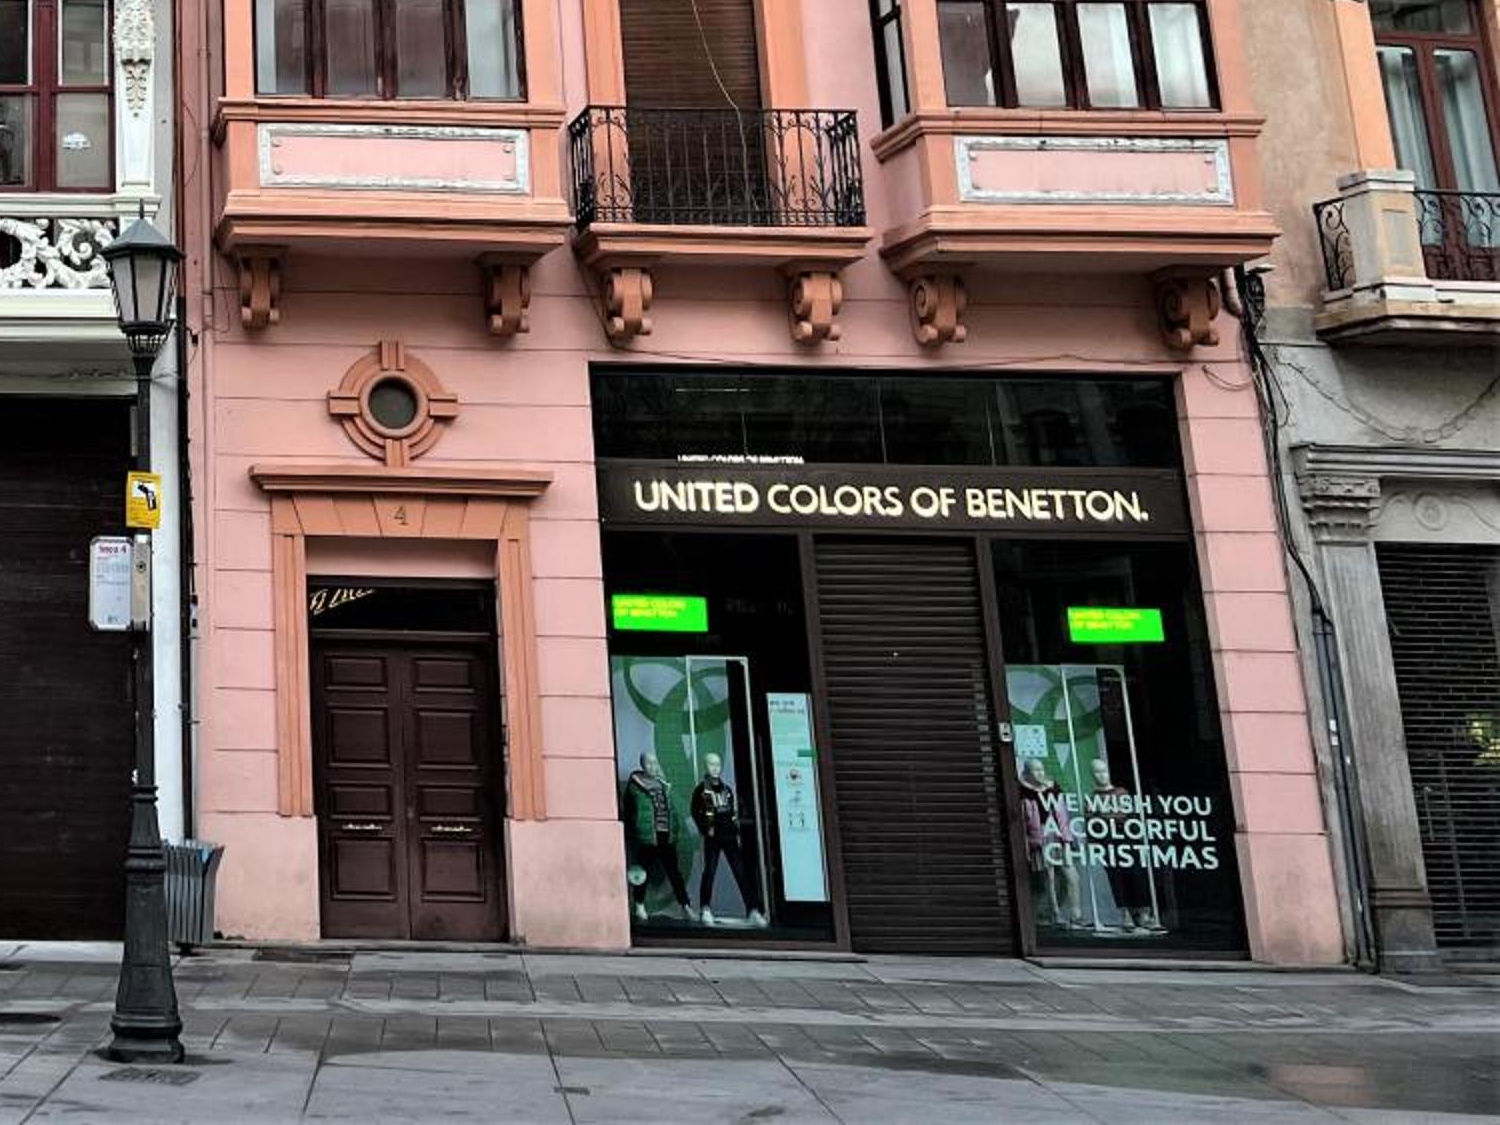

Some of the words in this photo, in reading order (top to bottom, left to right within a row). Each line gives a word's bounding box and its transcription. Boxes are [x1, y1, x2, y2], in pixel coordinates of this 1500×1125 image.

[634, 480, 760, 513] UNITED
[767, 484, 903, 517] COLORS
[910, 487, 956, 518] OF
[394, 505, 409, 526] 4
[1039, 792, 1079, 812] WE
[1087, 794, 1151, 814] WISH
[1157, 795, 1212, 816] YOU
[1043, 817, 1062, 836] A
[1069, 817, 1216, 842] COLORFUL
[1044, 842, 1220, 870] CHRISTMAS
